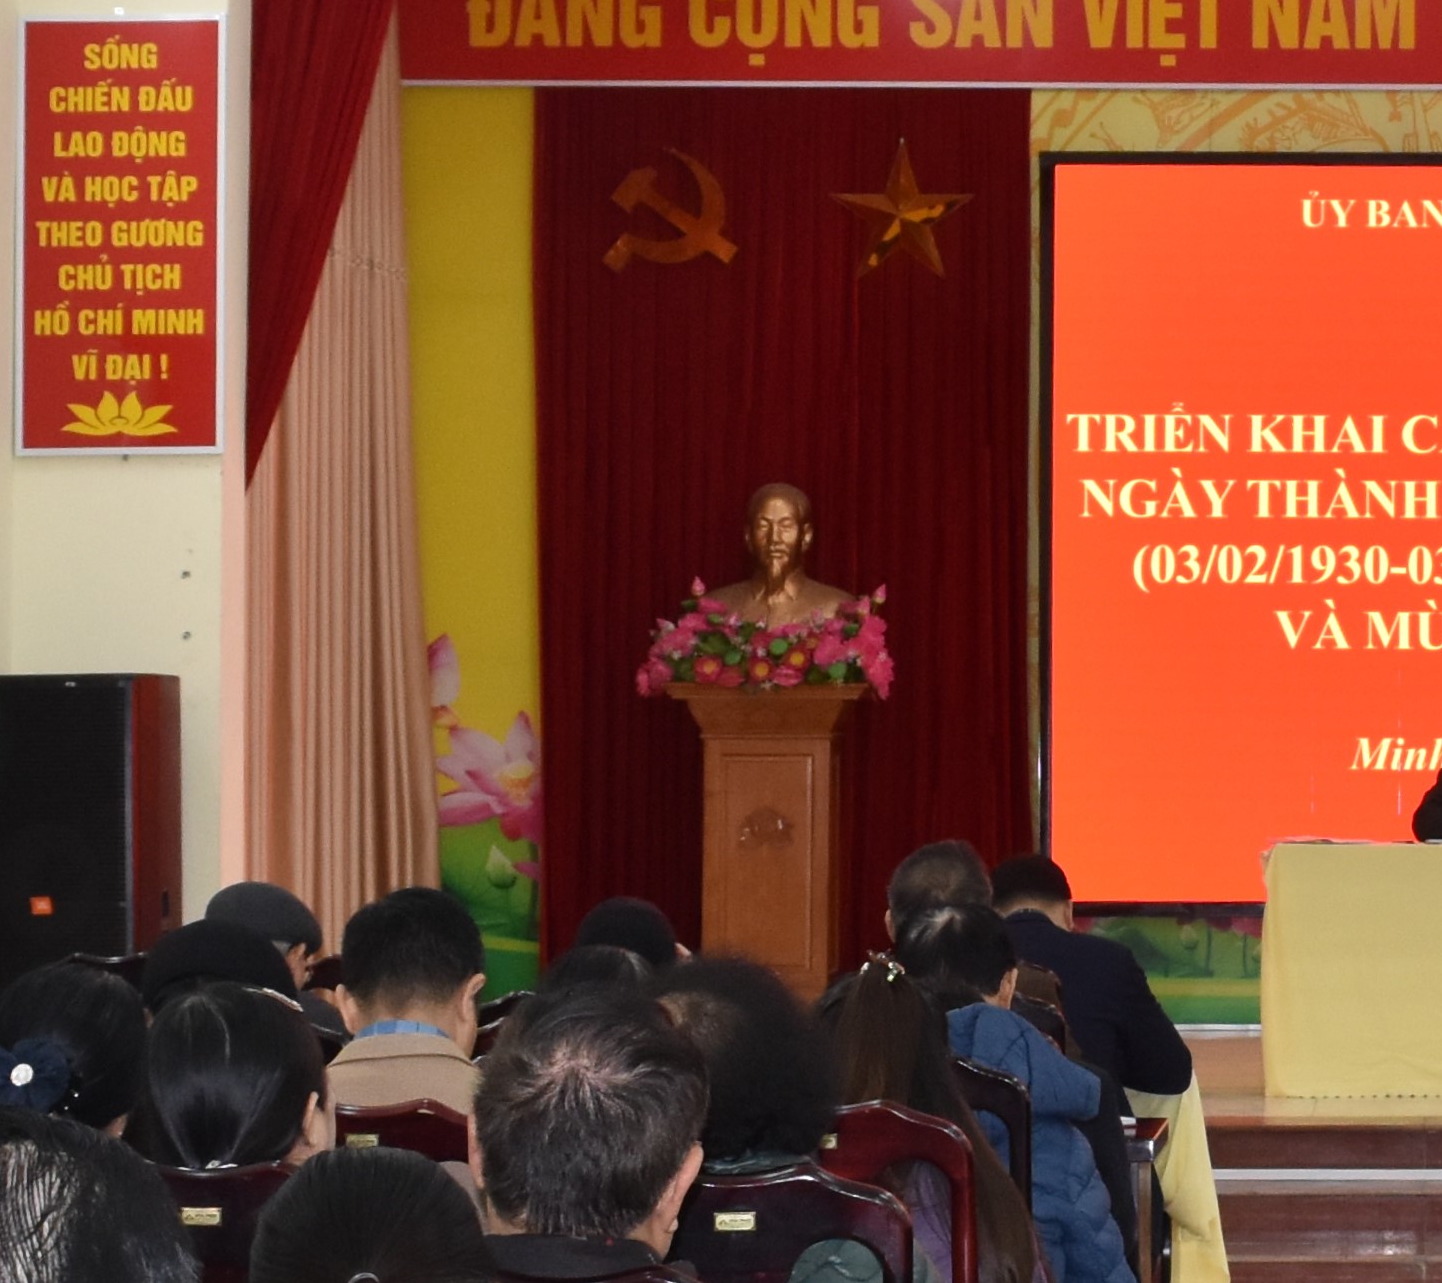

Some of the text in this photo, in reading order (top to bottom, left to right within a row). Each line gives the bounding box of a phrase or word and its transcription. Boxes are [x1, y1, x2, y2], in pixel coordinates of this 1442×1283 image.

[83, 35, 159, 70] SỐNG
[49, 78, 194, 113] CHIẾN ĐẤU
[53, 126, 187, 164] LAO ĐỘNG
[42, 170, 199, 209] VÀ HỌC TẬP
[1301, 190, 1357, 229] ỦY
[37, 219, 204, 248] THEO GƯƠNG
[58, 254, 182, 295] CHỦ TỊCH
[34, 301, 205, 336] HỒ CHÍ MINH
[72, 349, 169, 386] VĨ ĐẠI !
[1065, 402, 1232, 454] TRIỂN
[1248, 414, 1386, 454] KHAI
[1079, 468, 1237, 520] NGÀY
[1246, 468, 1440, 520] THÀNH
[1275, 598, 1351, 651] VÀ
